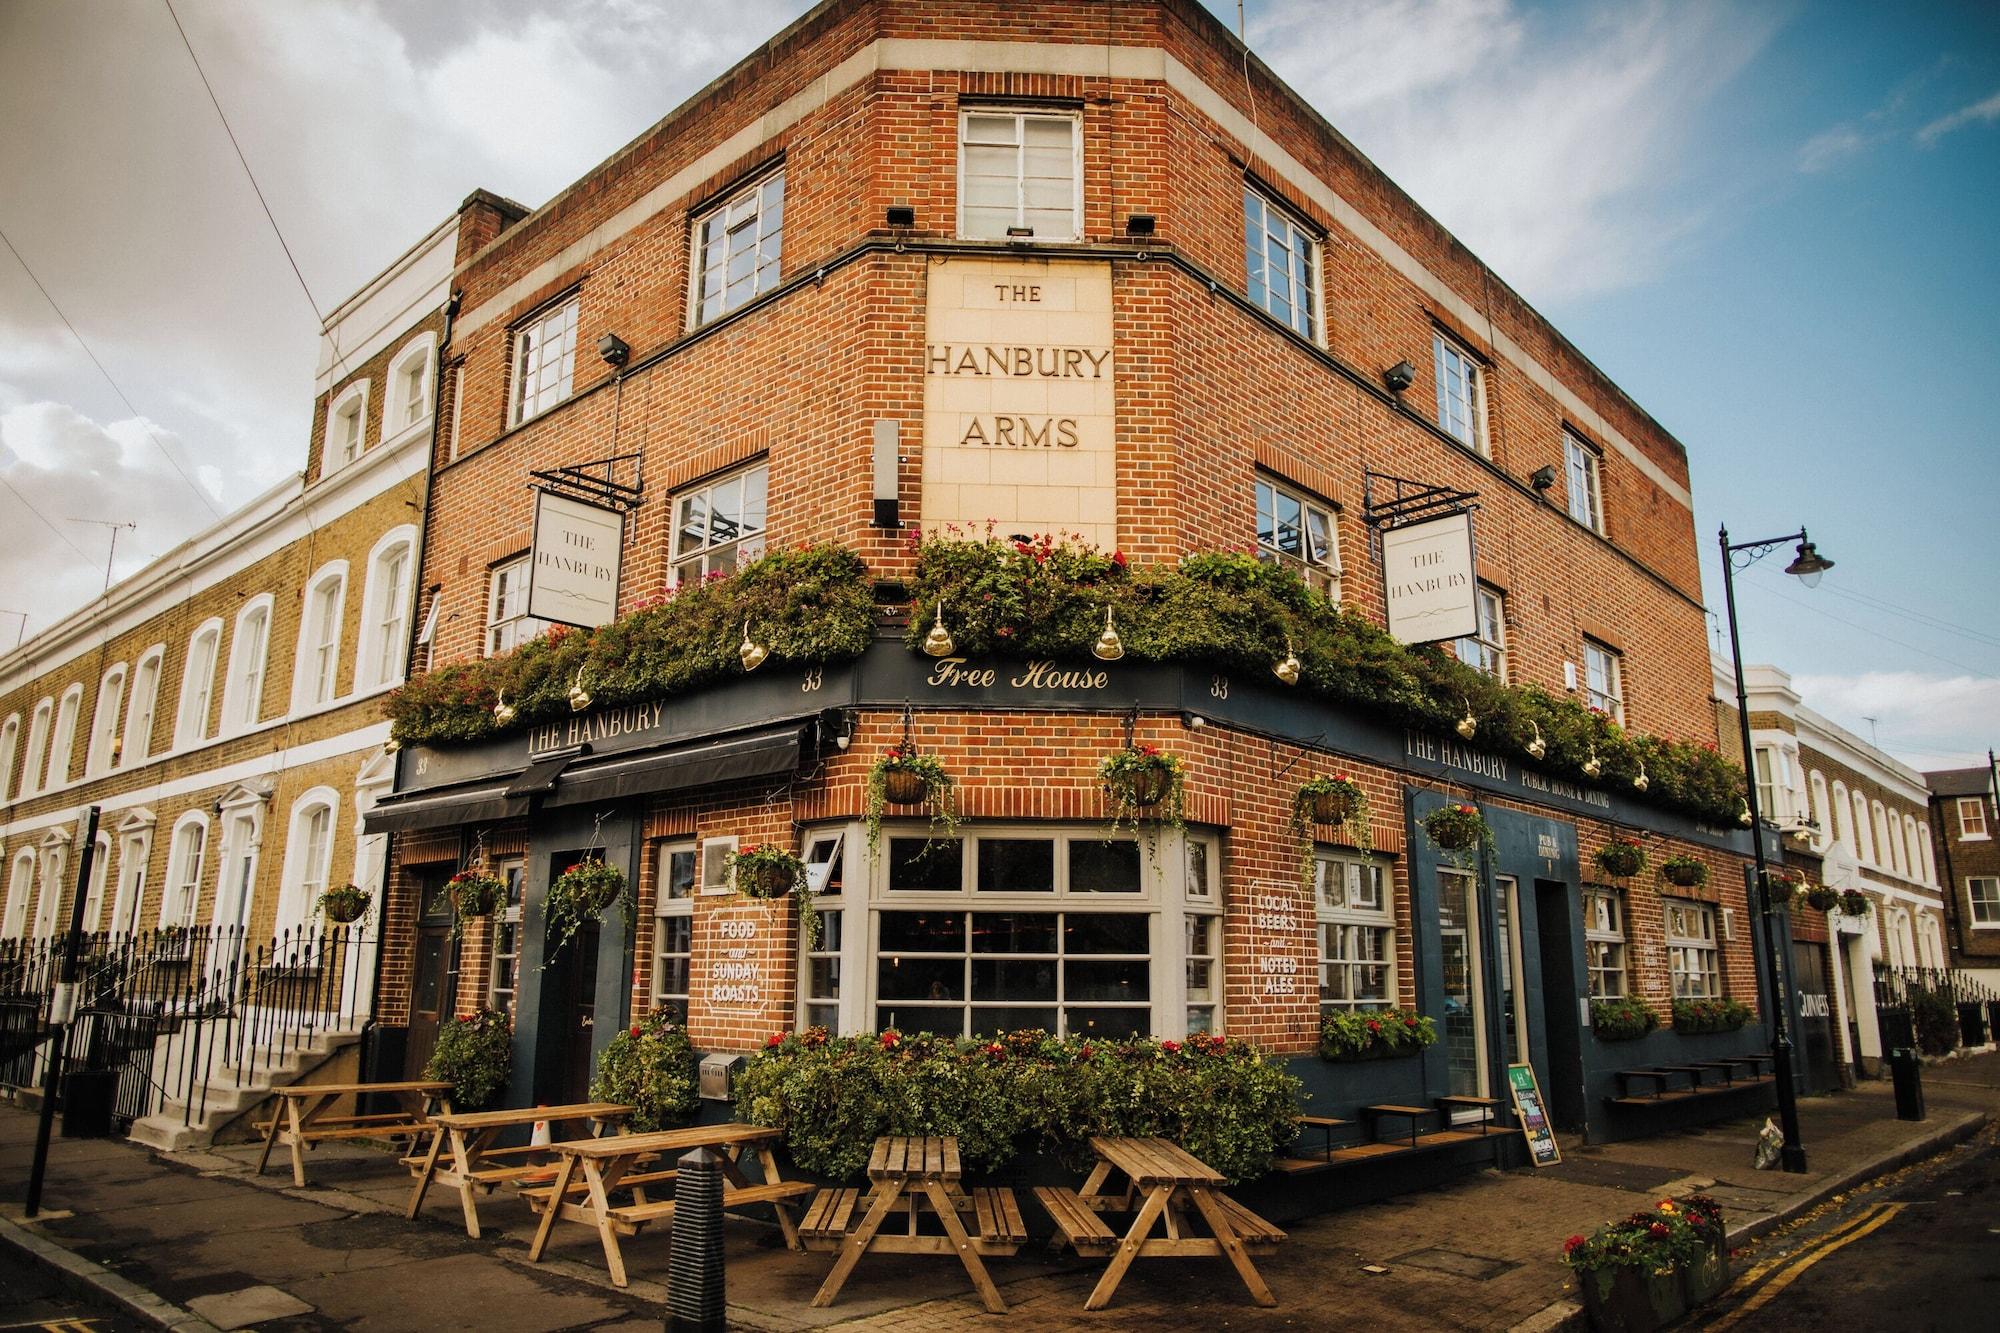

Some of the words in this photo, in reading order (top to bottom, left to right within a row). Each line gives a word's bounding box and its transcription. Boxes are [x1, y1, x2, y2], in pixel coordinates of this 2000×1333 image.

[994, 285, 1041, 302] THE
[927, 345, 1110, 378] HANBURY
[960, 415, 1079, 447] ARMS
[562, 529, 597, 552] THE
[538, 551, 613, 582] HANBURY
[1410, 549, 1445, 569] THE
[1391, 571, 1467, 599] HANBURY
[801, 667, 823, 692] 33
[926, 657, 997, 689] Free
[1010, 658, 1109, 690] House
[1210, 673, 1229, 700] 33
[526, 722, 562, 754] THE
[566, 700, 666, 746] HANBURY
[1406, 728, 1437, 761] THE
[1441, 739, 1509, 782] HANBURY
[415, 756, 428, 776] 33
[1521, 768, 1550, 793] PUBLIC
[1551, 778, 1576, 799] HOUSE
[1585, 788, 1610, 809] DINING
[1538, 833, 1552, 847] PUB
[1538, 846, 1560, 860] DINING
[1257, 894, 1295, 912] LOCAL
[720, 920, 757, 940] FOOD
[1257, 914, 1297, 932] BEERS
[728, 944, 748, 960] and
[1269, 938, 1286, 949] and
[711, 963, 761, 981] SUNDAY
[1260, 956, 1297, 975] NOTED
[711, 984, 760, 1004] ROASTS
[1264, 976, 1295, 995] ALES
[1797, 990, 1830, 1017] GUINNESS
